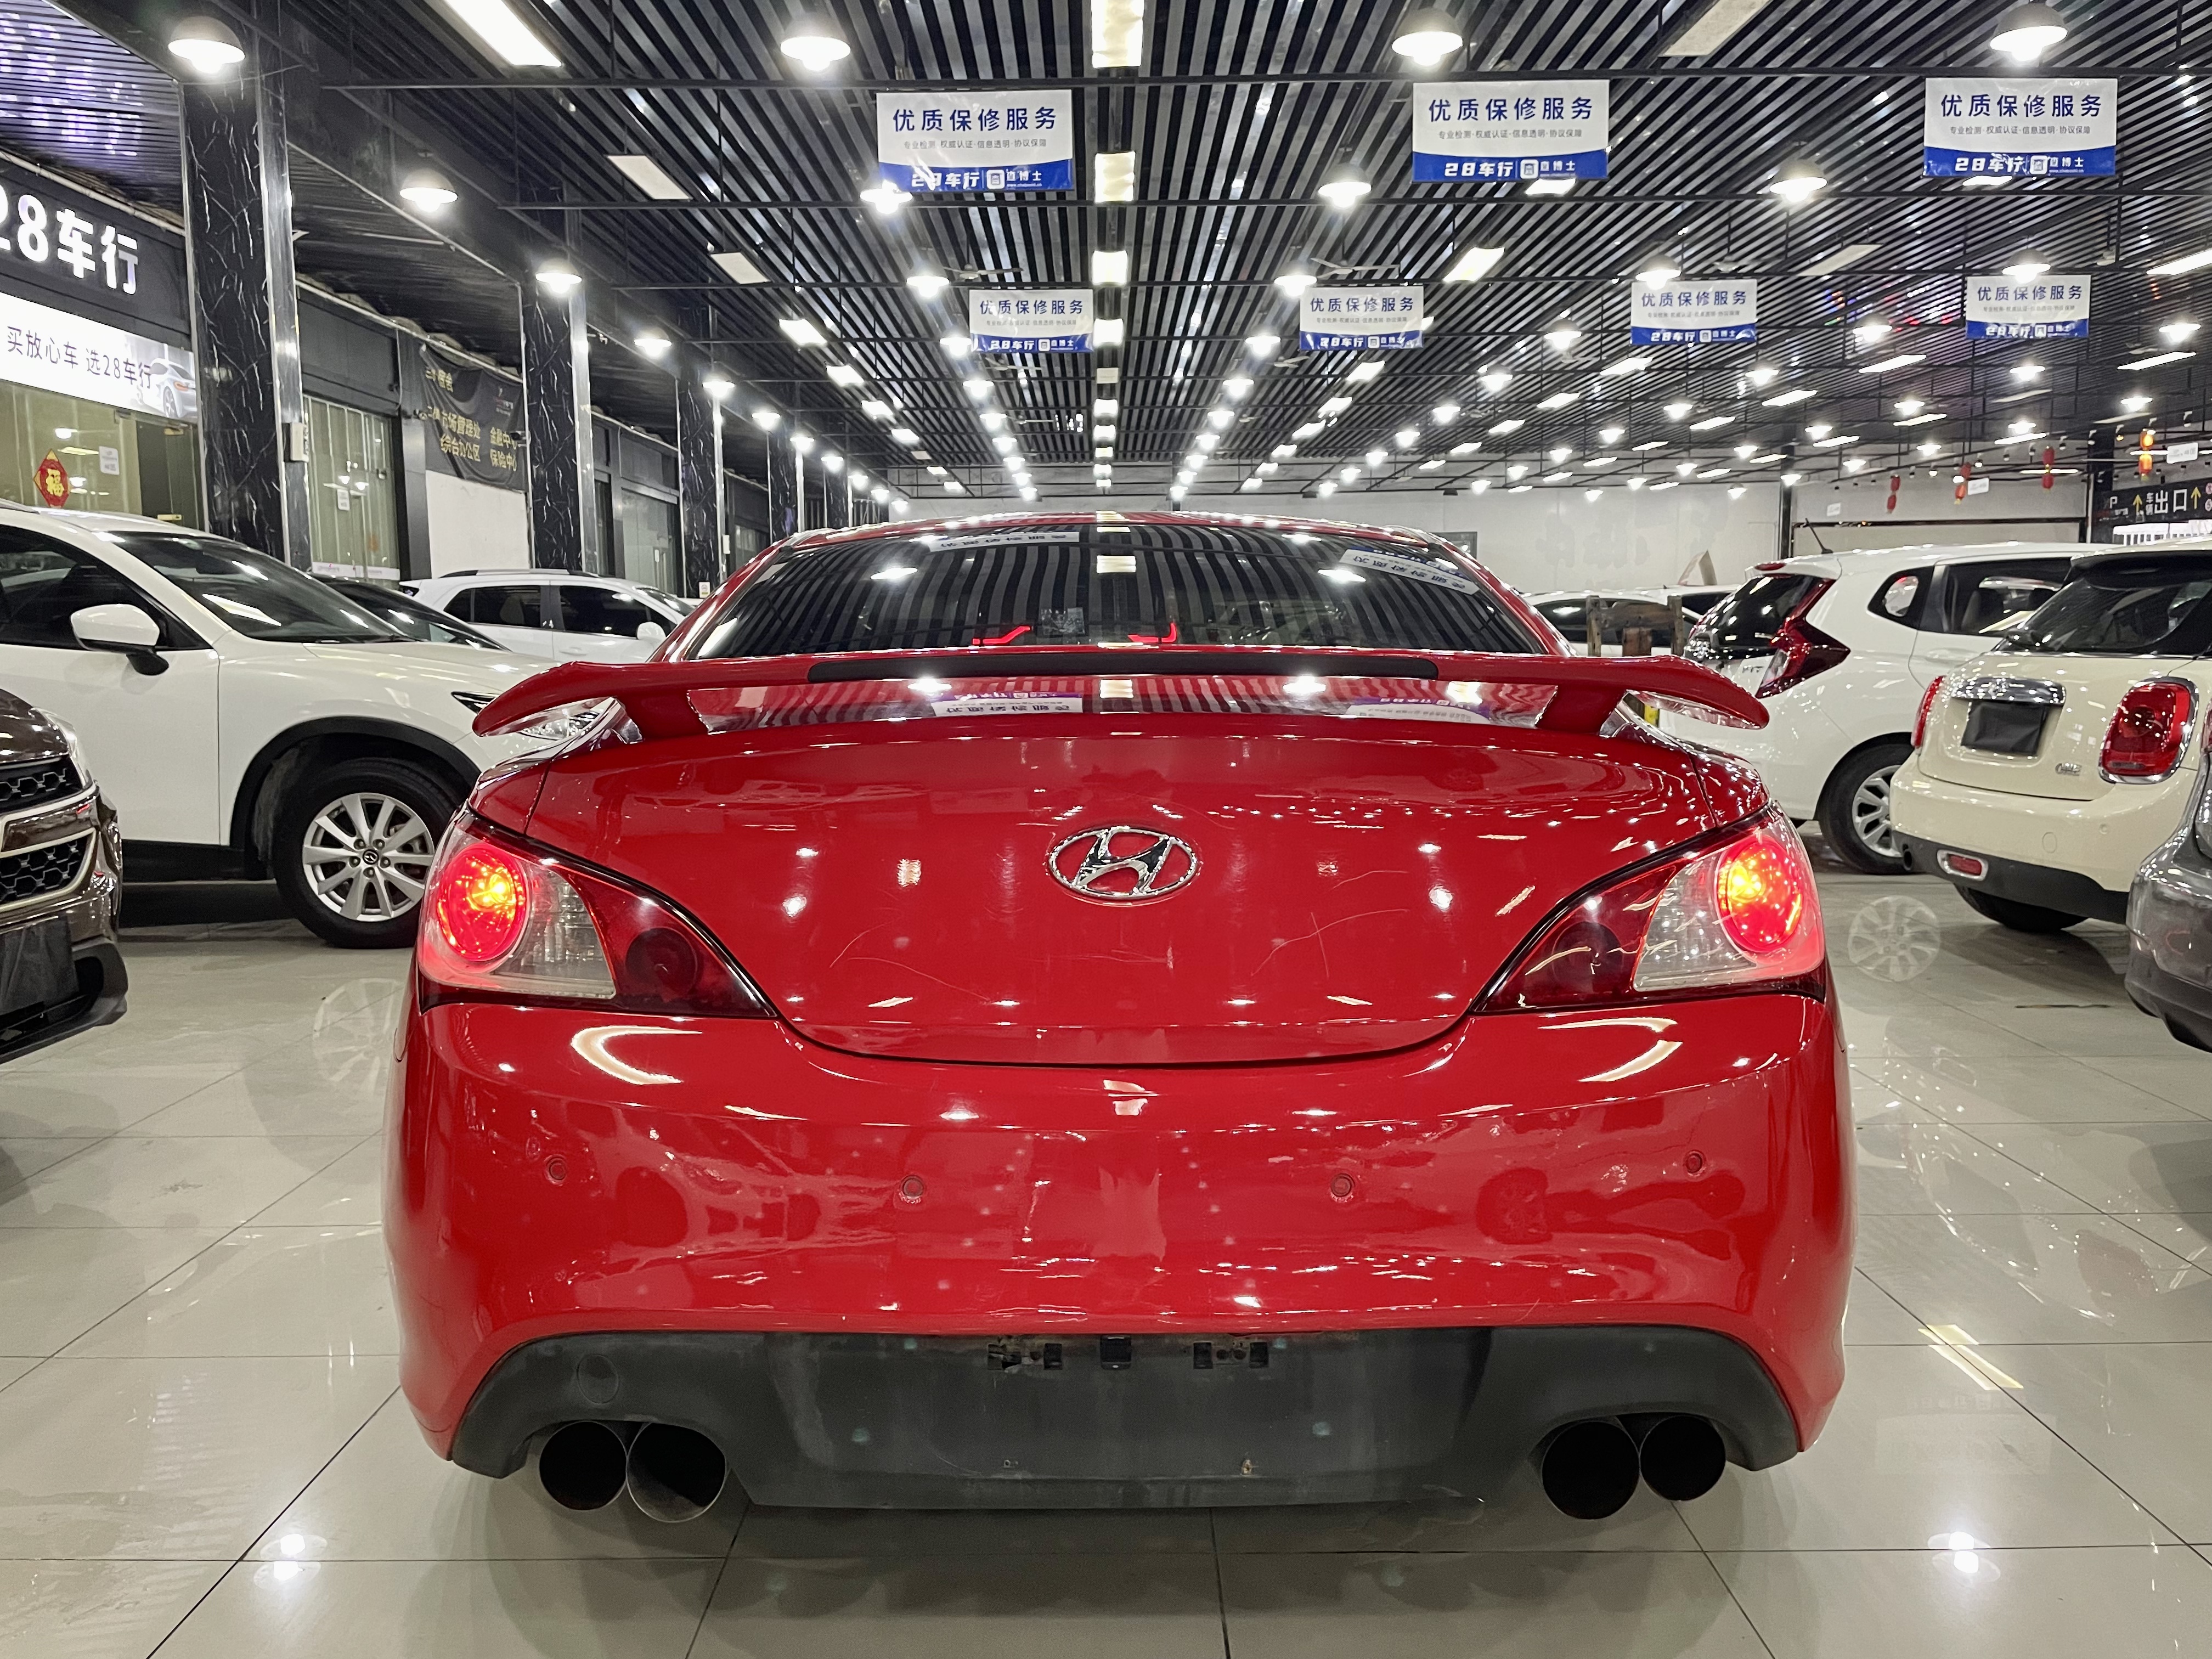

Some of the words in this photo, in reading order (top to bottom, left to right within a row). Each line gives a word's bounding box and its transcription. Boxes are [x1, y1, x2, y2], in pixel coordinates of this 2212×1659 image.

[1429, 97, 1593, 122] 优质保修服务
[1941, 94, 2102, 117] 优质保修服务
[893, 106, 1057, 132] 优质保修服务
[1443, 161, 1514, 177] 28车行
[1954, 156, 2024, 173] 28车行
[1641, 290, 1747, 307] 优质保修服务
[1977, 285, 2083, 301] 优质保修服务
[979, 300, 1084, 315] 优质保修服务
[1310, 297, 1414, 312] 优质保修服务
[7, 326, 78, 369] 买放心车
[86, 347, 151, 389] 选28车行
[2109, 496, 2118, 509] P
[2154, 489, 2187, 514] 出口
[1742, 665, 1763, 674] FIT
